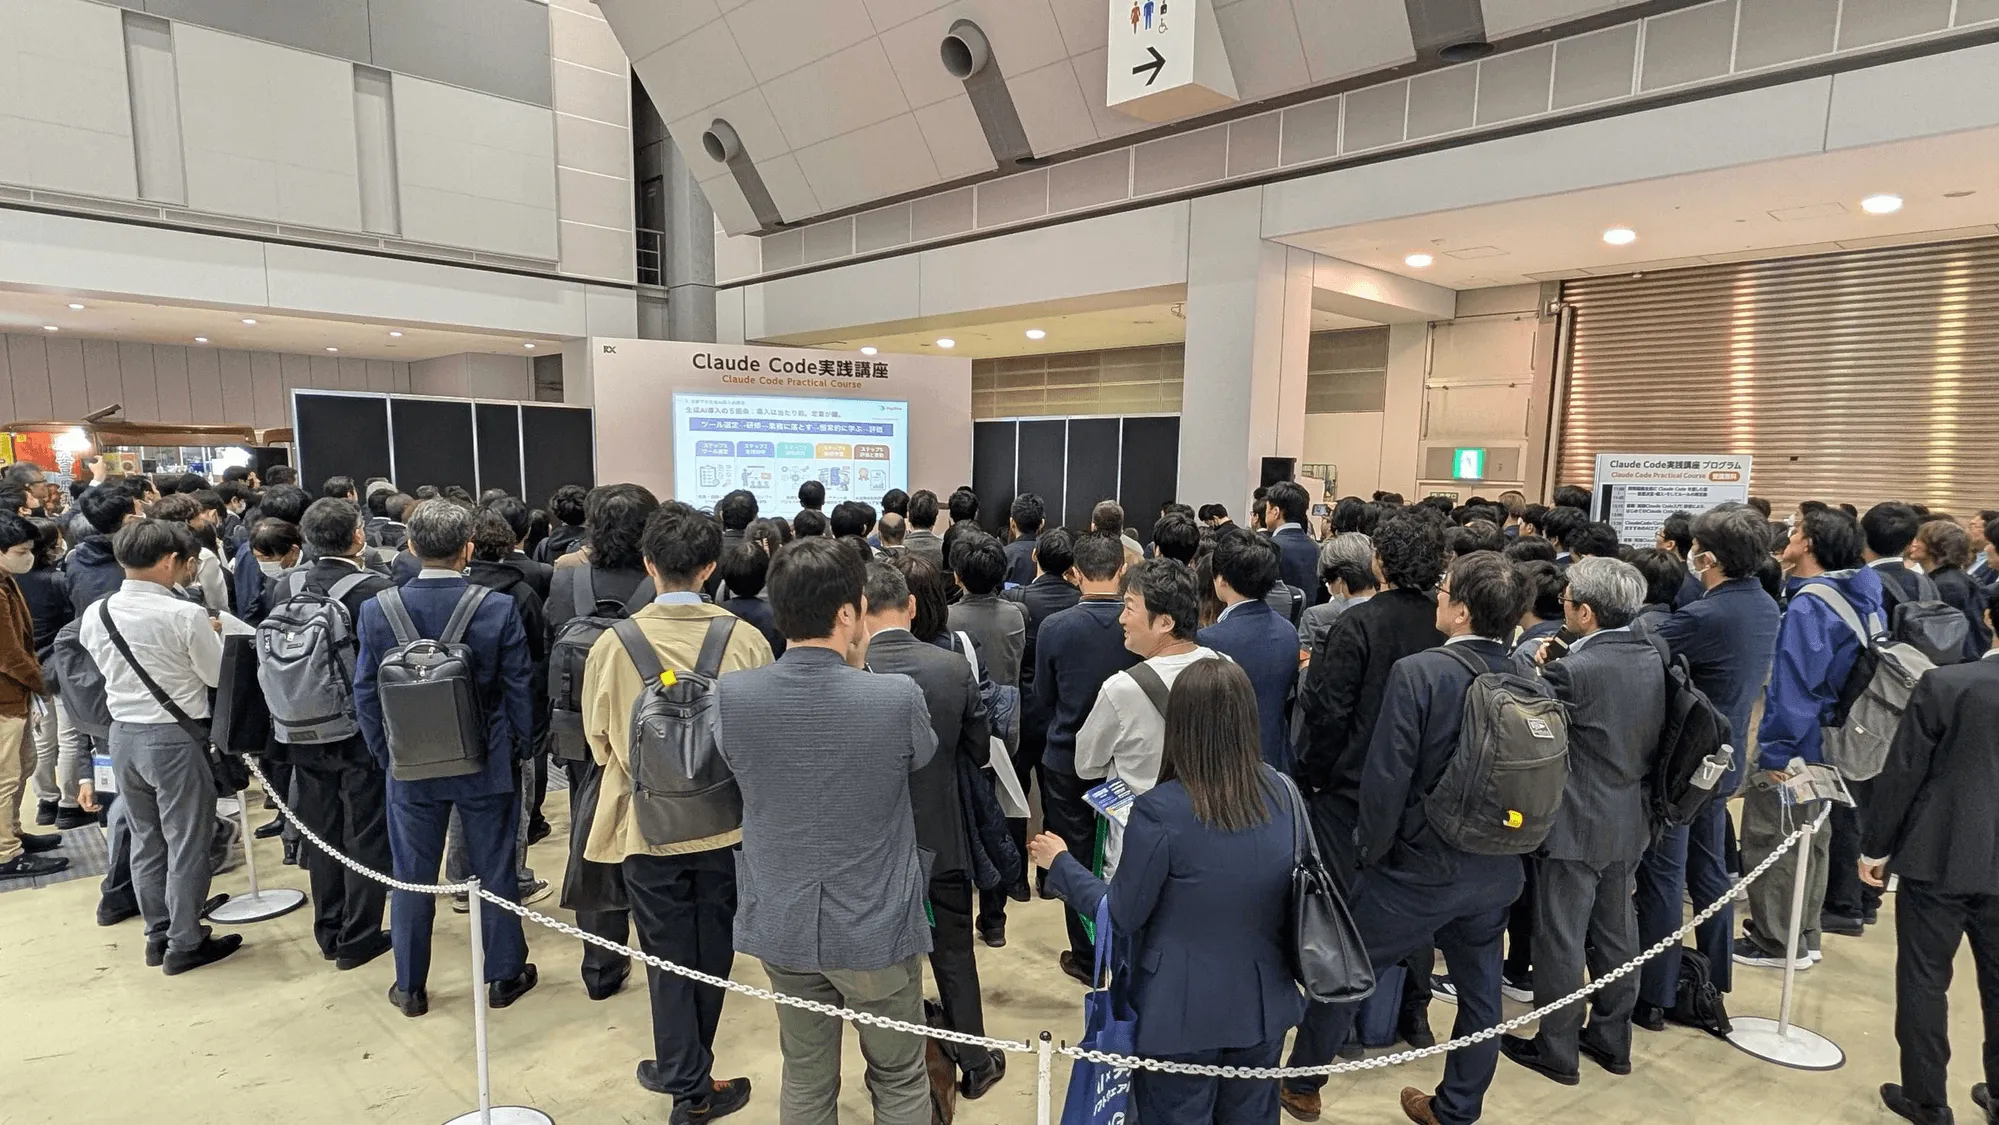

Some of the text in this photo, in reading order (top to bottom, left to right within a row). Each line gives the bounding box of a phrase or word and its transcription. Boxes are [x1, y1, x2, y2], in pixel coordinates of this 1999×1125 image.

[692, 353, 889, 379] Claude Code実践講座
[722, 374, 862, 389] Claude Code Practical Course
[1610, 460, 1742, 470] Claude Code実践講座 プログラム
